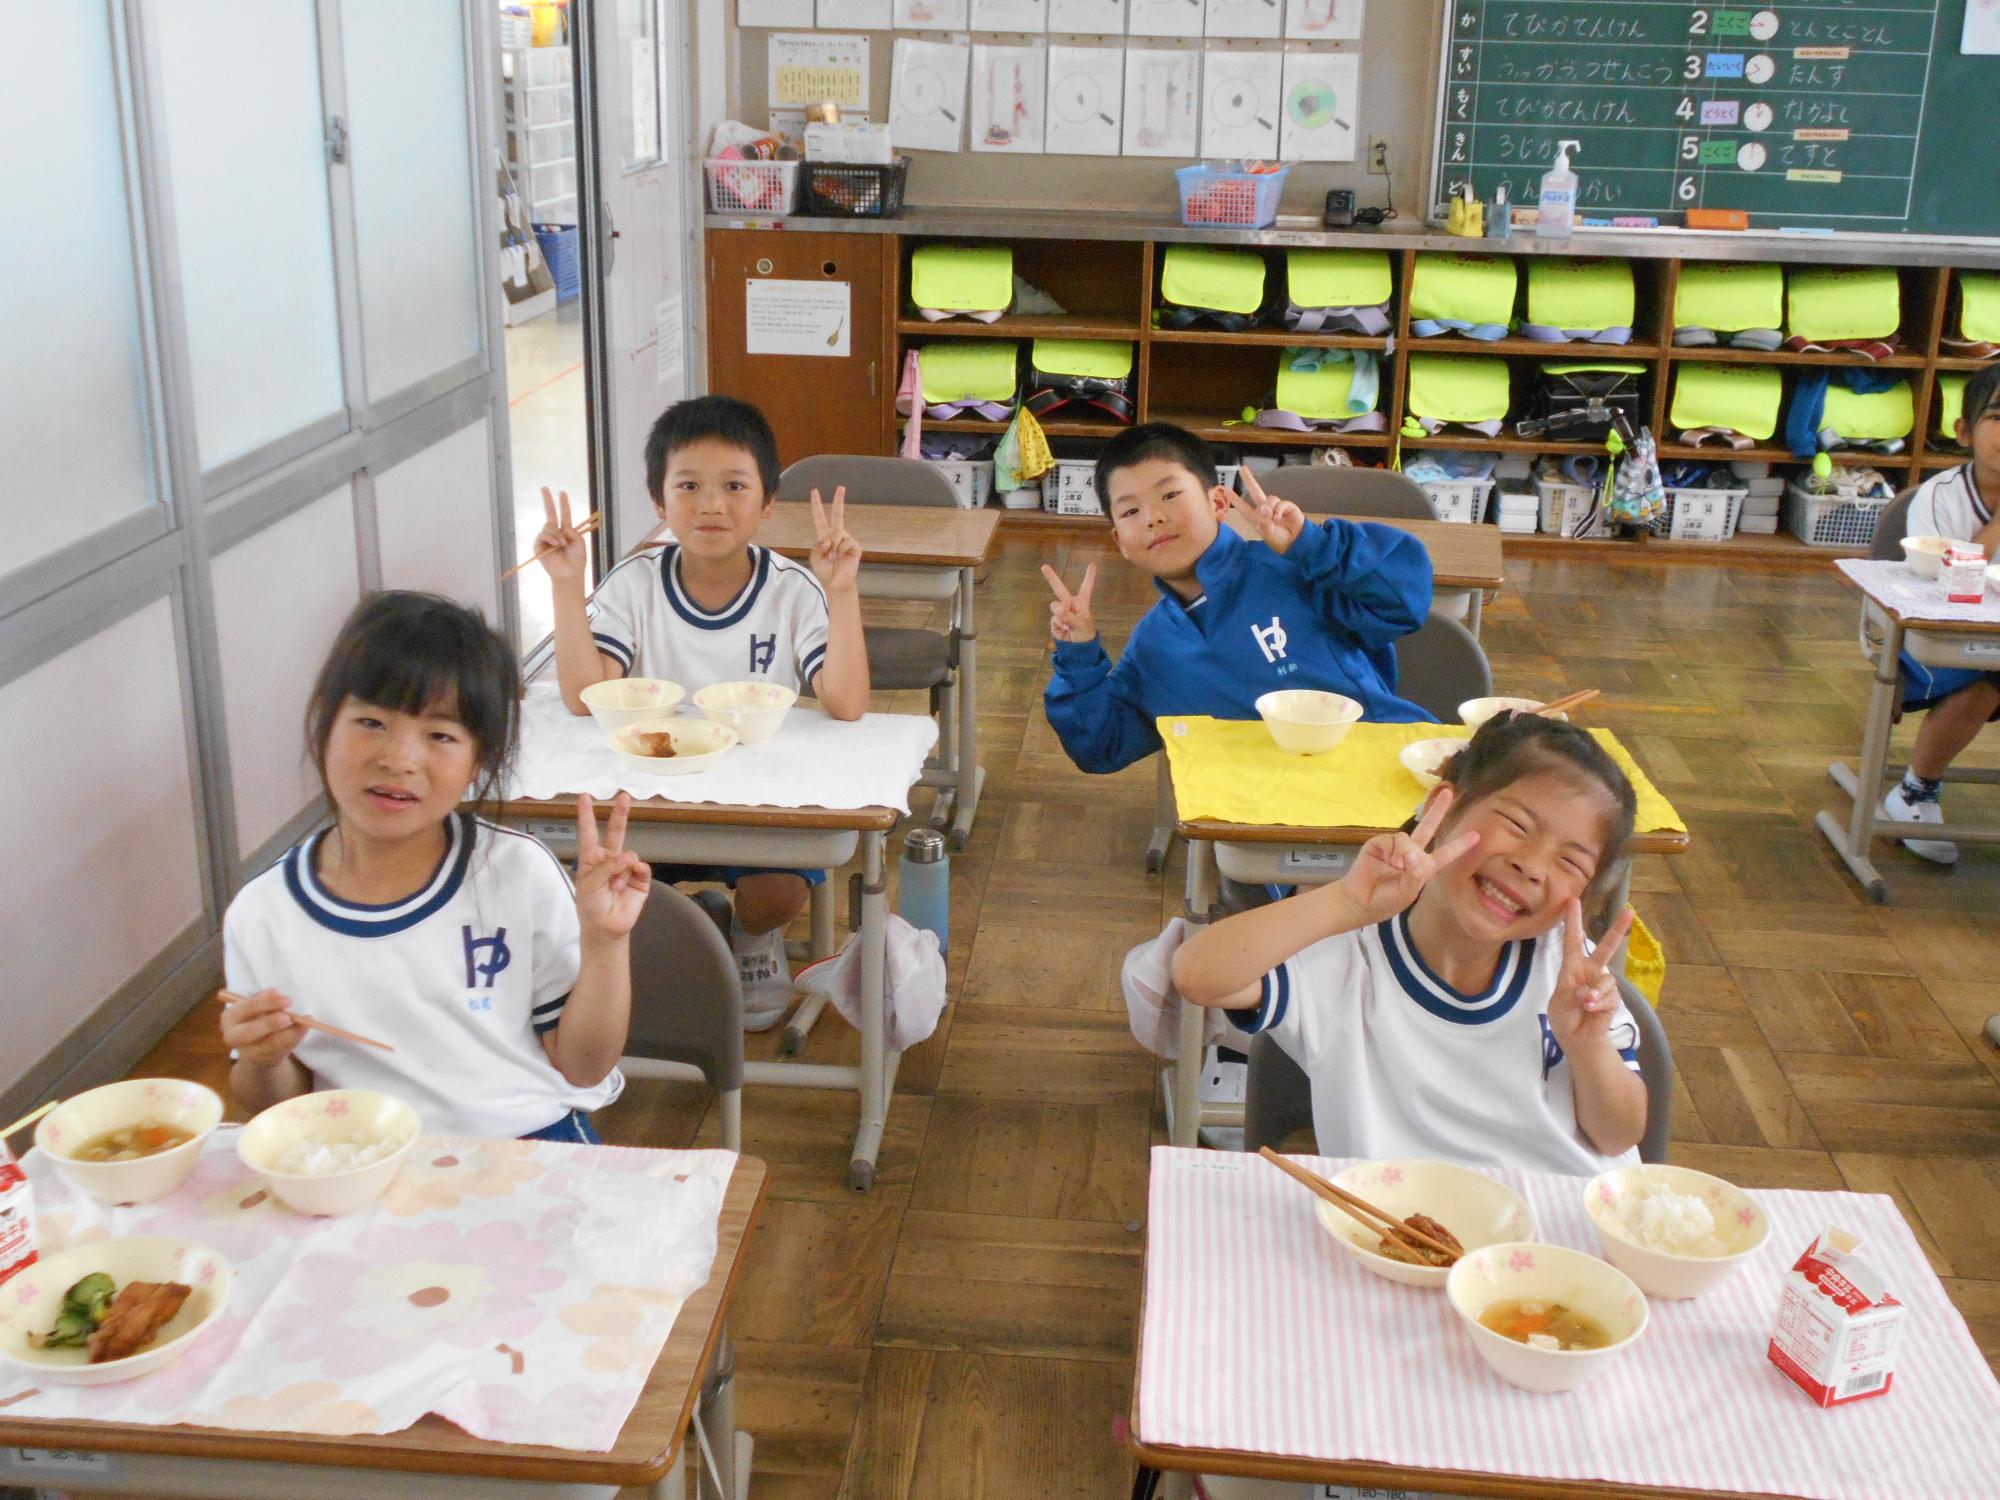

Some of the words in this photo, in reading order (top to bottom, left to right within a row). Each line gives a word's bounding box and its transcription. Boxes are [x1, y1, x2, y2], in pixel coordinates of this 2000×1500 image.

[1460, 12, 1476, 28] か
[1688, 10, 1709, 34] 2
[1717, 16, 1746, 30] こくご
[1457, 46, 1473, 74] すい
[1683, 55, 1701, 79] 3
[1707, 60, 1743, 72] たいいく
[1788, 64, 1847, 88] たんす
[1457, 87, 1470, 119] もく
[1676, 97, 1695, 121] 4
[1703, 106, 1736, 119] どうとく
[1783, 99, 1850, 124] なかよし
[1451, 132, 1466, 162] きん
[1681, 136, 1699, 160] 5
[1704, 145, 1732, 159] こくご
[1779, 144, 1838, 167] てすと
[1448, 180, 1464, 196] ど
[1678, 176, 1697, 201] 6
[953, 473, 961, 484] 2
[1064, 476, 1072, 487] 3
[1086, 476, 1093, 487] 4
[1451, 494, 1459, 506] 10
[1291, 849, 1300, 862] L
[19, 1446, 35, 1460] L
[1326, 1485, 1340, 1499] L
